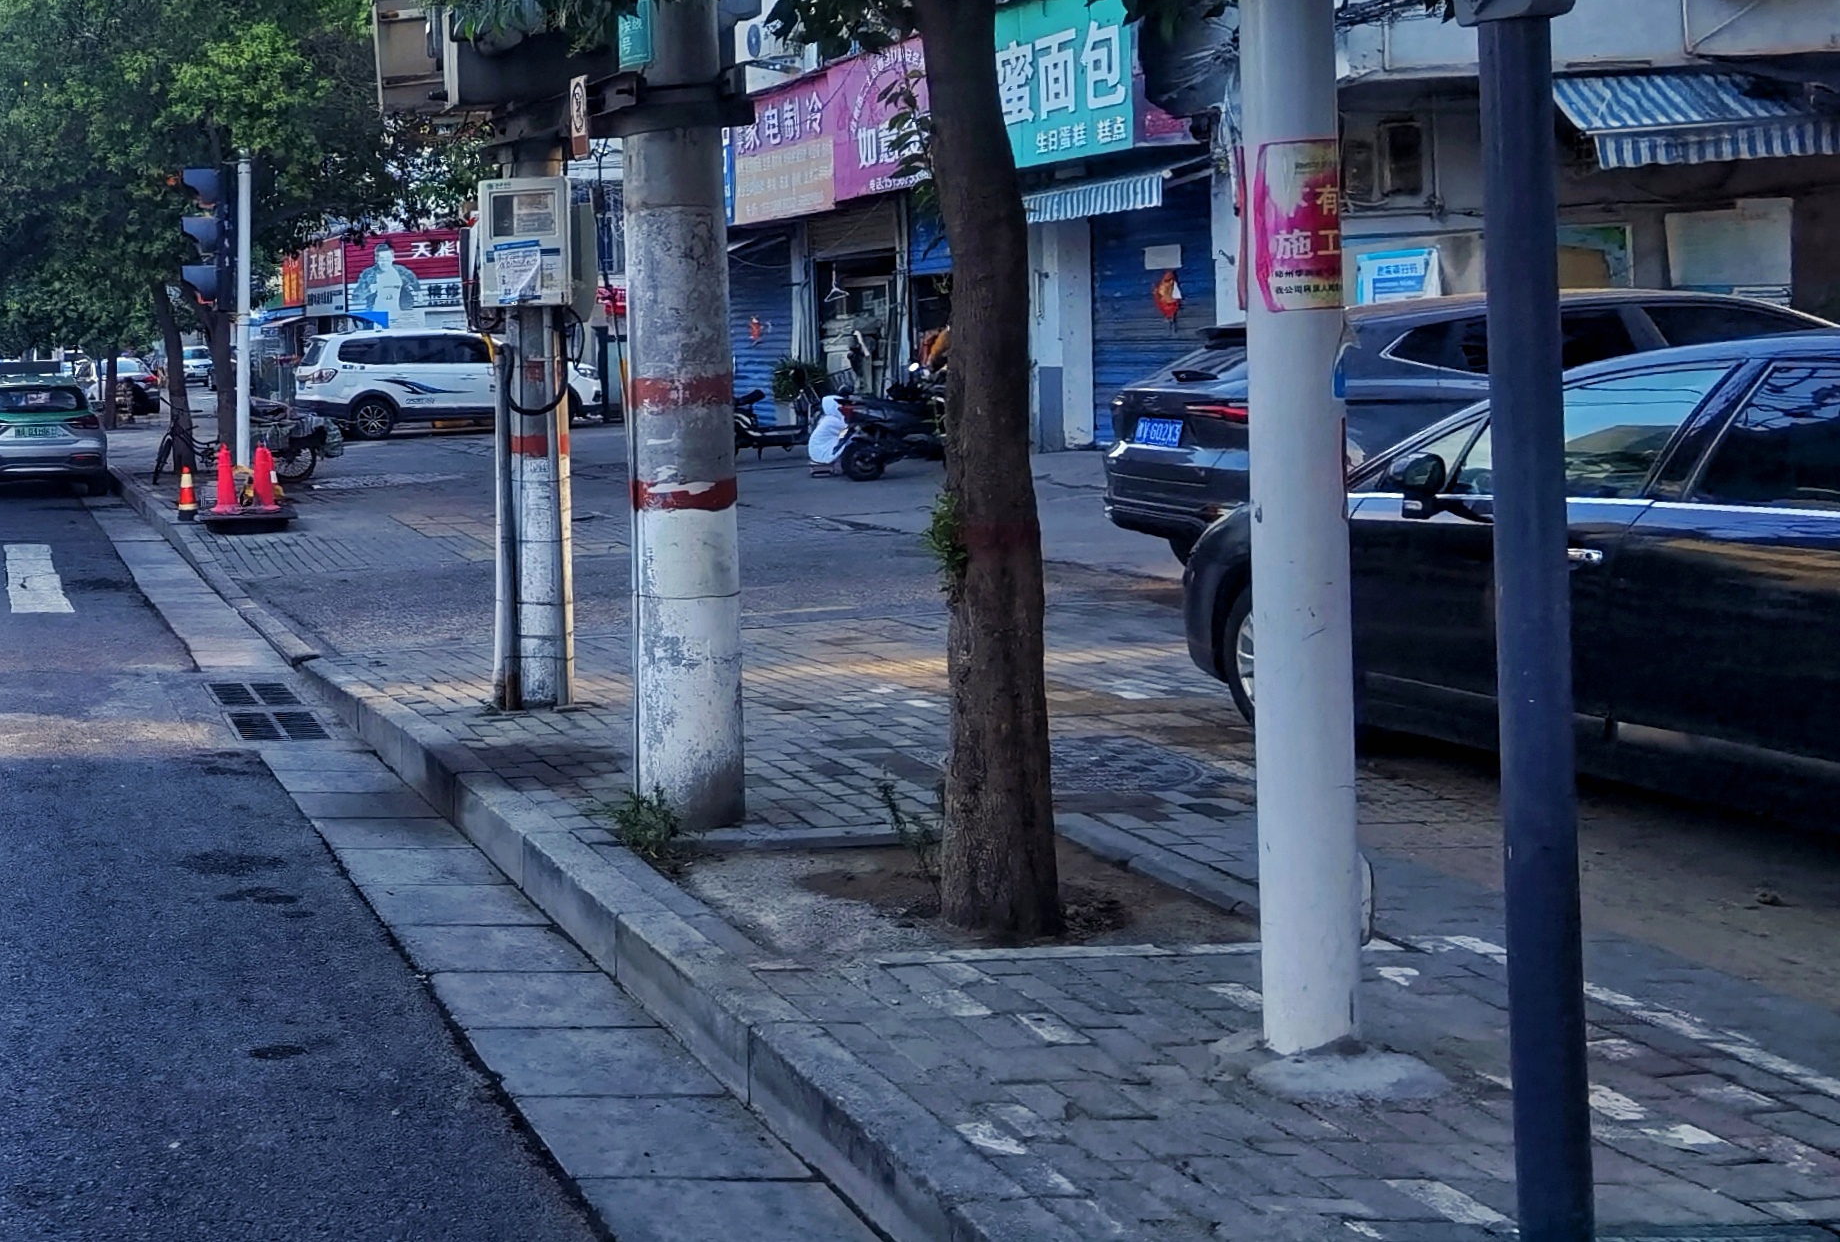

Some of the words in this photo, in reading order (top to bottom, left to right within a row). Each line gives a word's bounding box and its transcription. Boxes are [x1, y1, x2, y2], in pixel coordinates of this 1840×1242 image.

[1036, 121, 1088, 155] 生日蛋糕
[1096, 116, 1127, 145] 糕点
[1275, 229, 1341, 260] 施工
